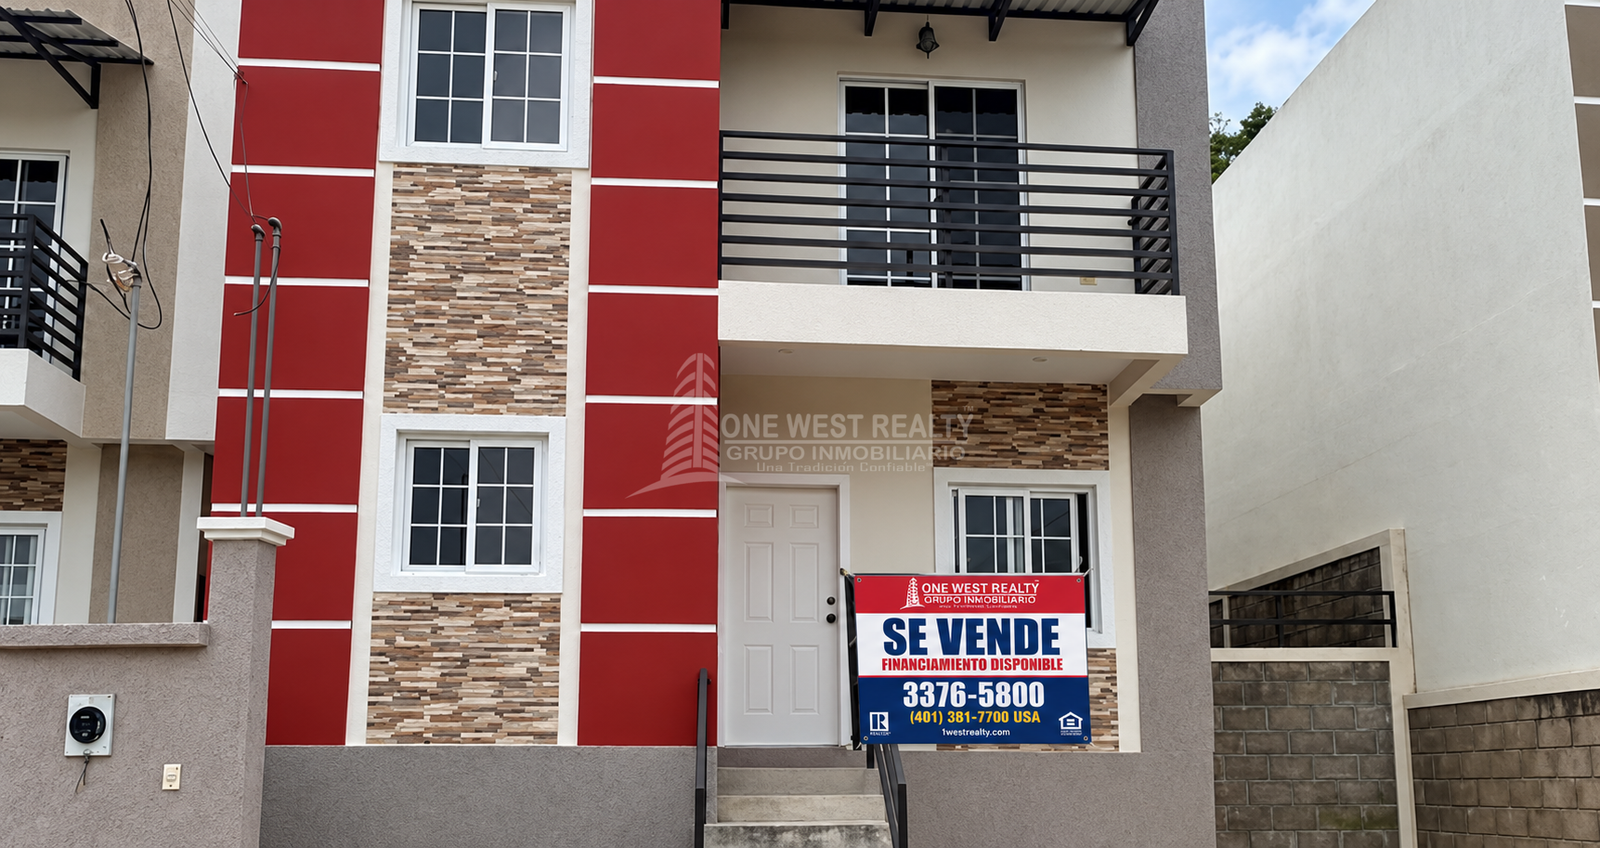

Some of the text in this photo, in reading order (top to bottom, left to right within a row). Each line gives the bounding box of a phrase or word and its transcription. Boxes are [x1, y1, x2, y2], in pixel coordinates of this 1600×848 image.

[921, 583, 1040, 594] ONE WEST REALTY
[964, 596, 1036, 604] INMOBILIARIO
[883, 617, 1061, 656] SE VENDE
[882, 658, 1063, 671] FINANCIAMIENTO DISPONIBLE
[903, 681, 1045, 708] 3376-5800
[910, 710, 1041, 725] (401) 381-7700 USA
[942, 728, 1011, 738] 1westrealty.com
